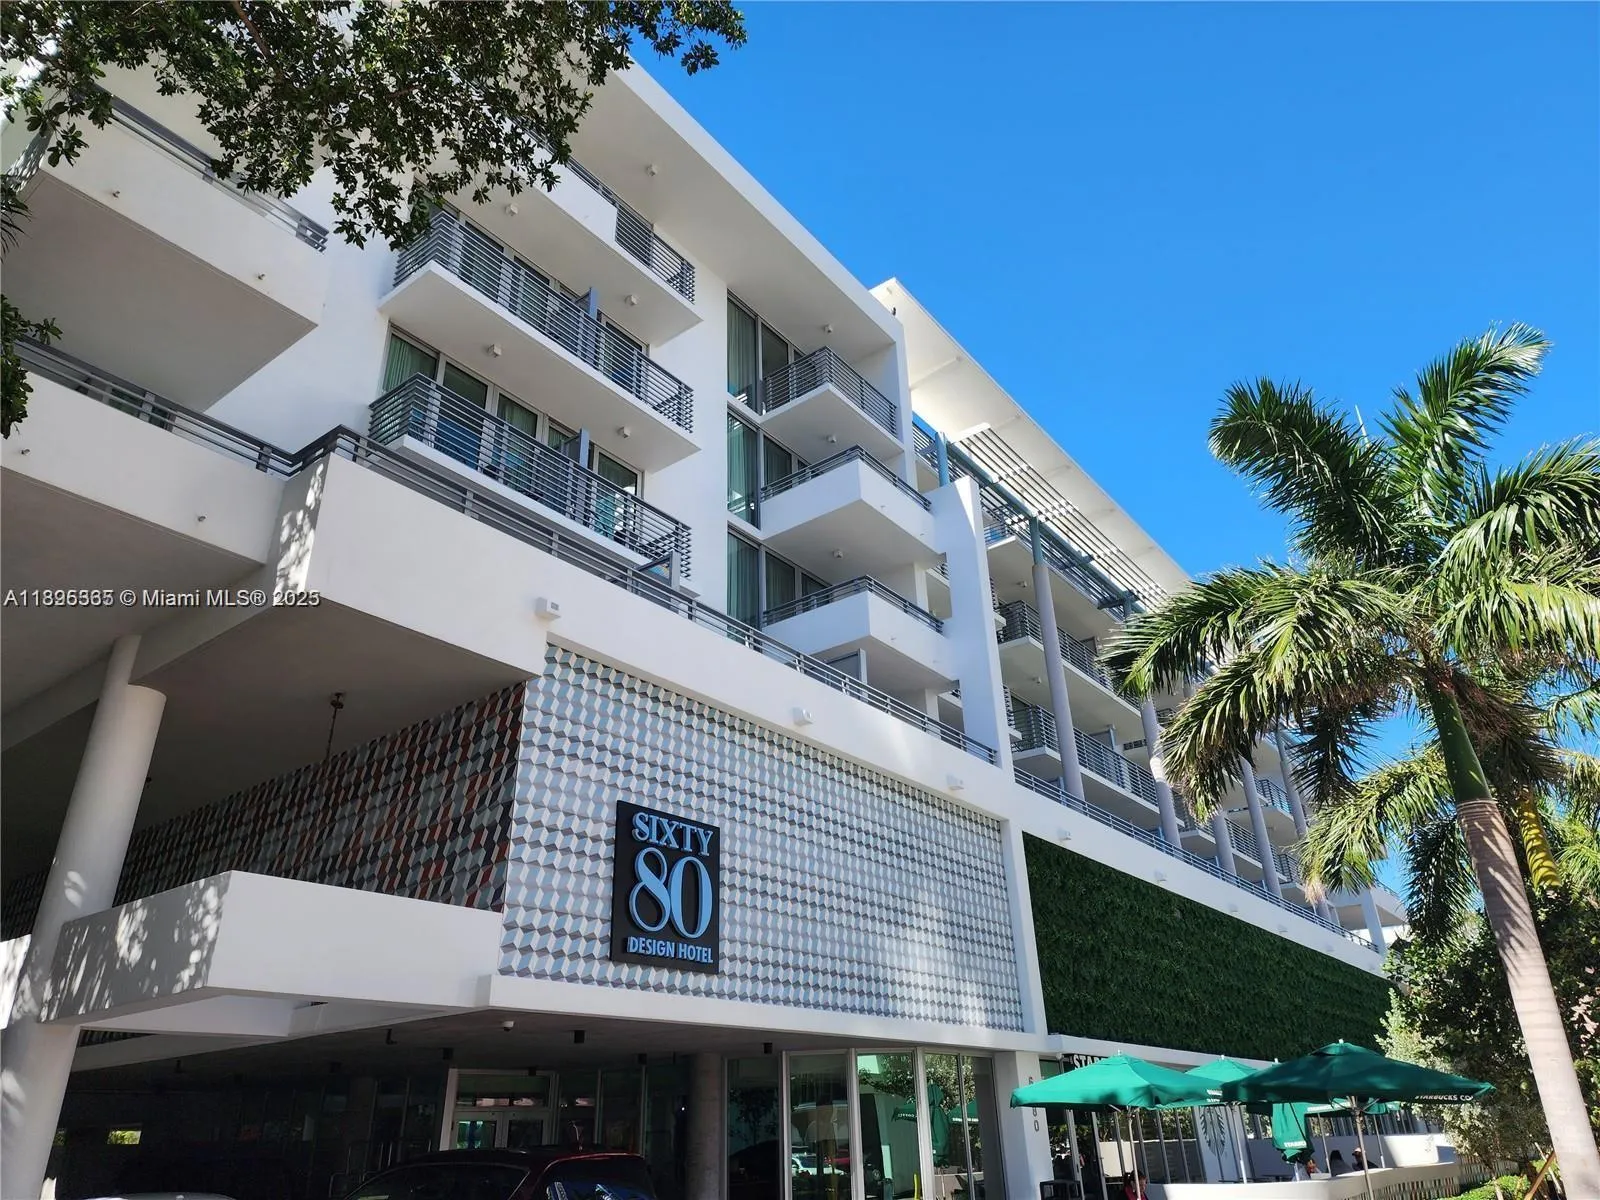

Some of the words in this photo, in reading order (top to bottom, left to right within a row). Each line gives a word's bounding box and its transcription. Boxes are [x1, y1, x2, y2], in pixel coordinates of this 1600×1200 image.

[632, 812, 713, 857] SIXTY
[629, 847, 713, 939] 80
[627, 936, 675, 958] DESIGN
[677, 943, 714, 964] HOTEL
